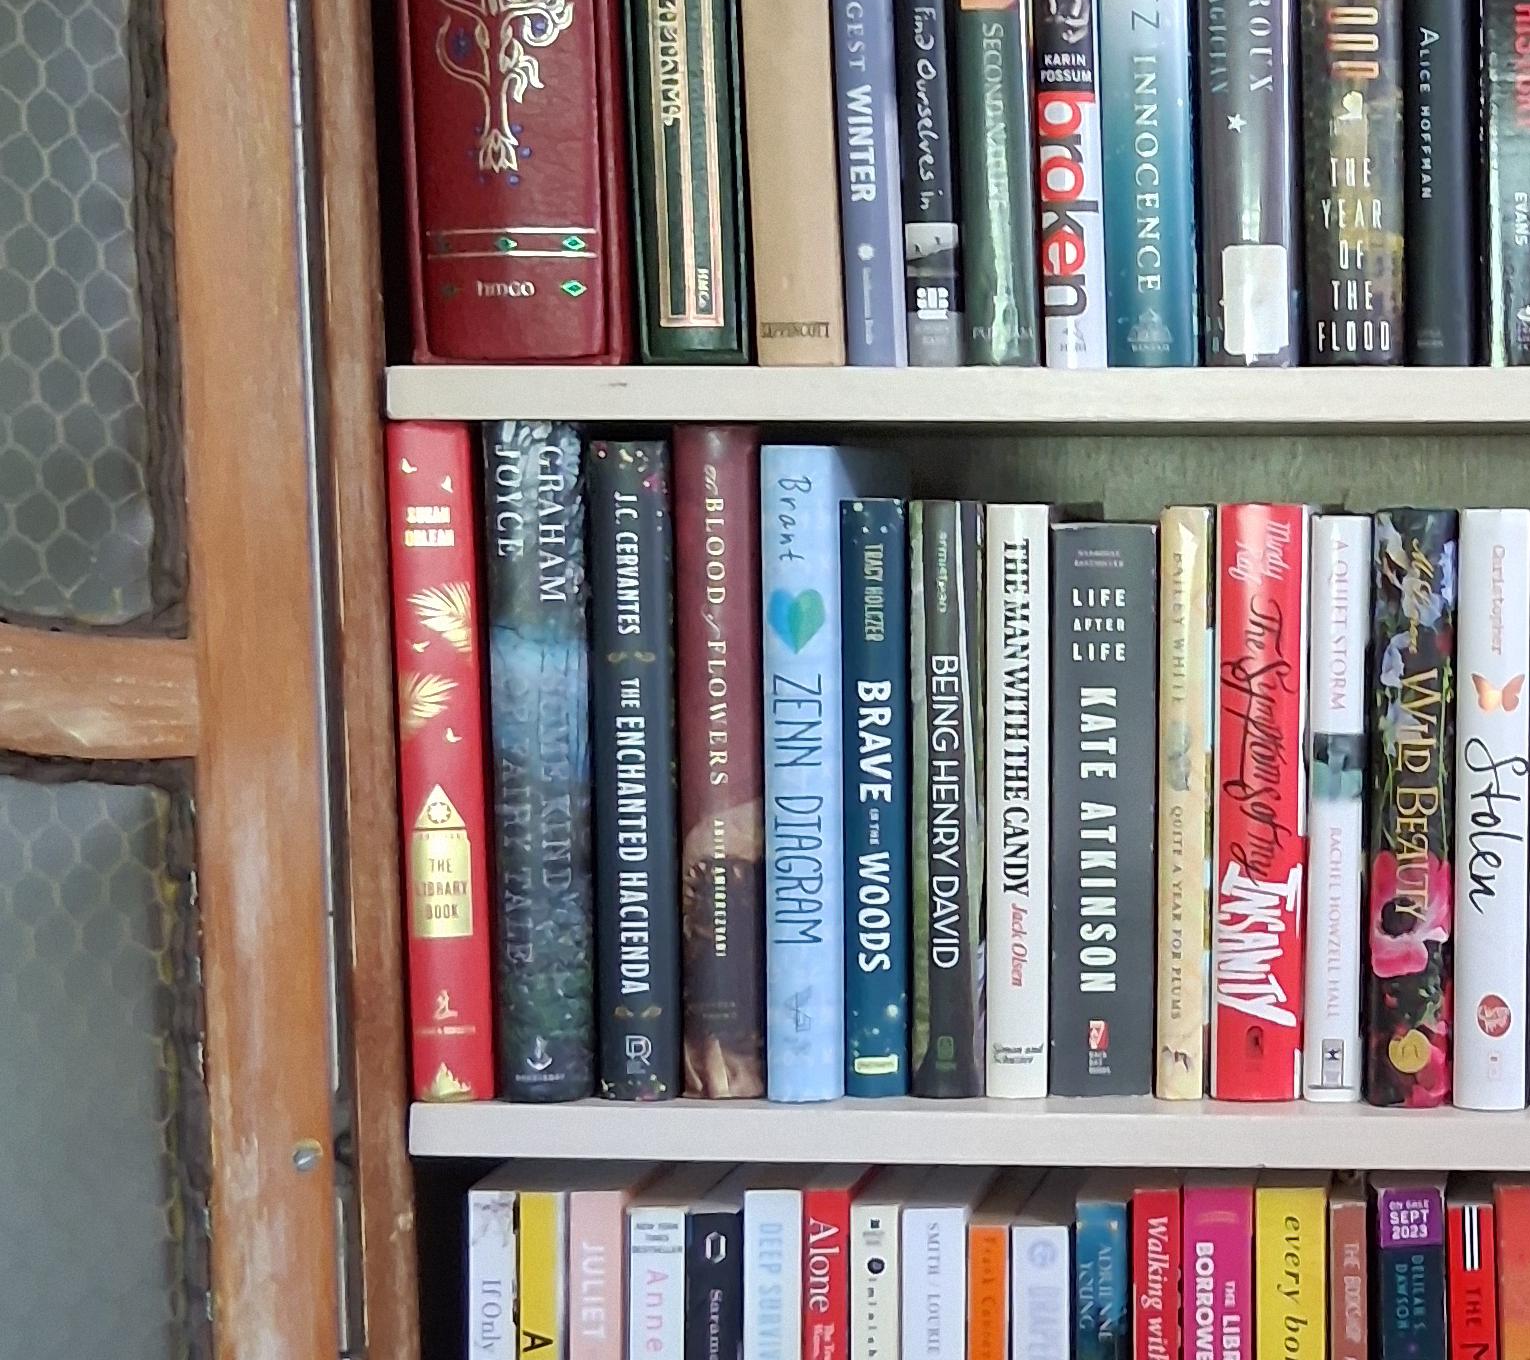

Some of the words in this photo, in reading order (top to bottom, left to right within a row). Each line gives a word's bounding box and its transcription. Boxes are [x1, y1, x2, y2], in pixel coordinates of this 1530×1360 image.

[1040, 69, 1092, 83] FOSSUM
[1044, 55, 1087, 66] KARIN
[848, 85, 876, 202] WINTER
[1133, 53, 1161, 293] INNOCENCE
[1331, 156, 1370, 188] THE
[1038, 91, 1092, 318] broken
[1321, 198, 1382, 231] YEAR
[1331, 279, 1373, 311] THE
[1338, 243, 1365, 270] OF
[1318, 321, 1390, 352] FLOOD
[1072, 588, 1126, 607] LIFE
[1074, 616, 1125, 633] AFTER
[620, 677, 640, 709] THE
[1072, 640, 1126, 661] LIFE
[772, 673, 823, 768] ZENN
[856, 680, 891, 804] BRAVE
[931, 654, 958, 750] BEING
[1079, 686, 1117, 781] KATE
[615, 716, 647, 864] ENCHANTED
[932, 757, 959, 862] HENRY
[1466, 736, 1530, 915] Stolen
[773, 794, 824, 947] DIAGRAM
[858, 852, 890, 973] WOODS
[1080, 800, 1118, 994] ATKINSON
[619, 871, 650, 995] HACIENDA
[931, 868, 959, 968] DAVID
[1140, 1216, 1168, 1310] Walking
[1282, 1214, 1308, 1300] every
[1390, 1210, 1429, 1225] SEPT
[1392, 1225, 1428, 1238] 2023
[810, 1218, 839, 1314] Alone
[1148, 1318, 1169, 1354] with
